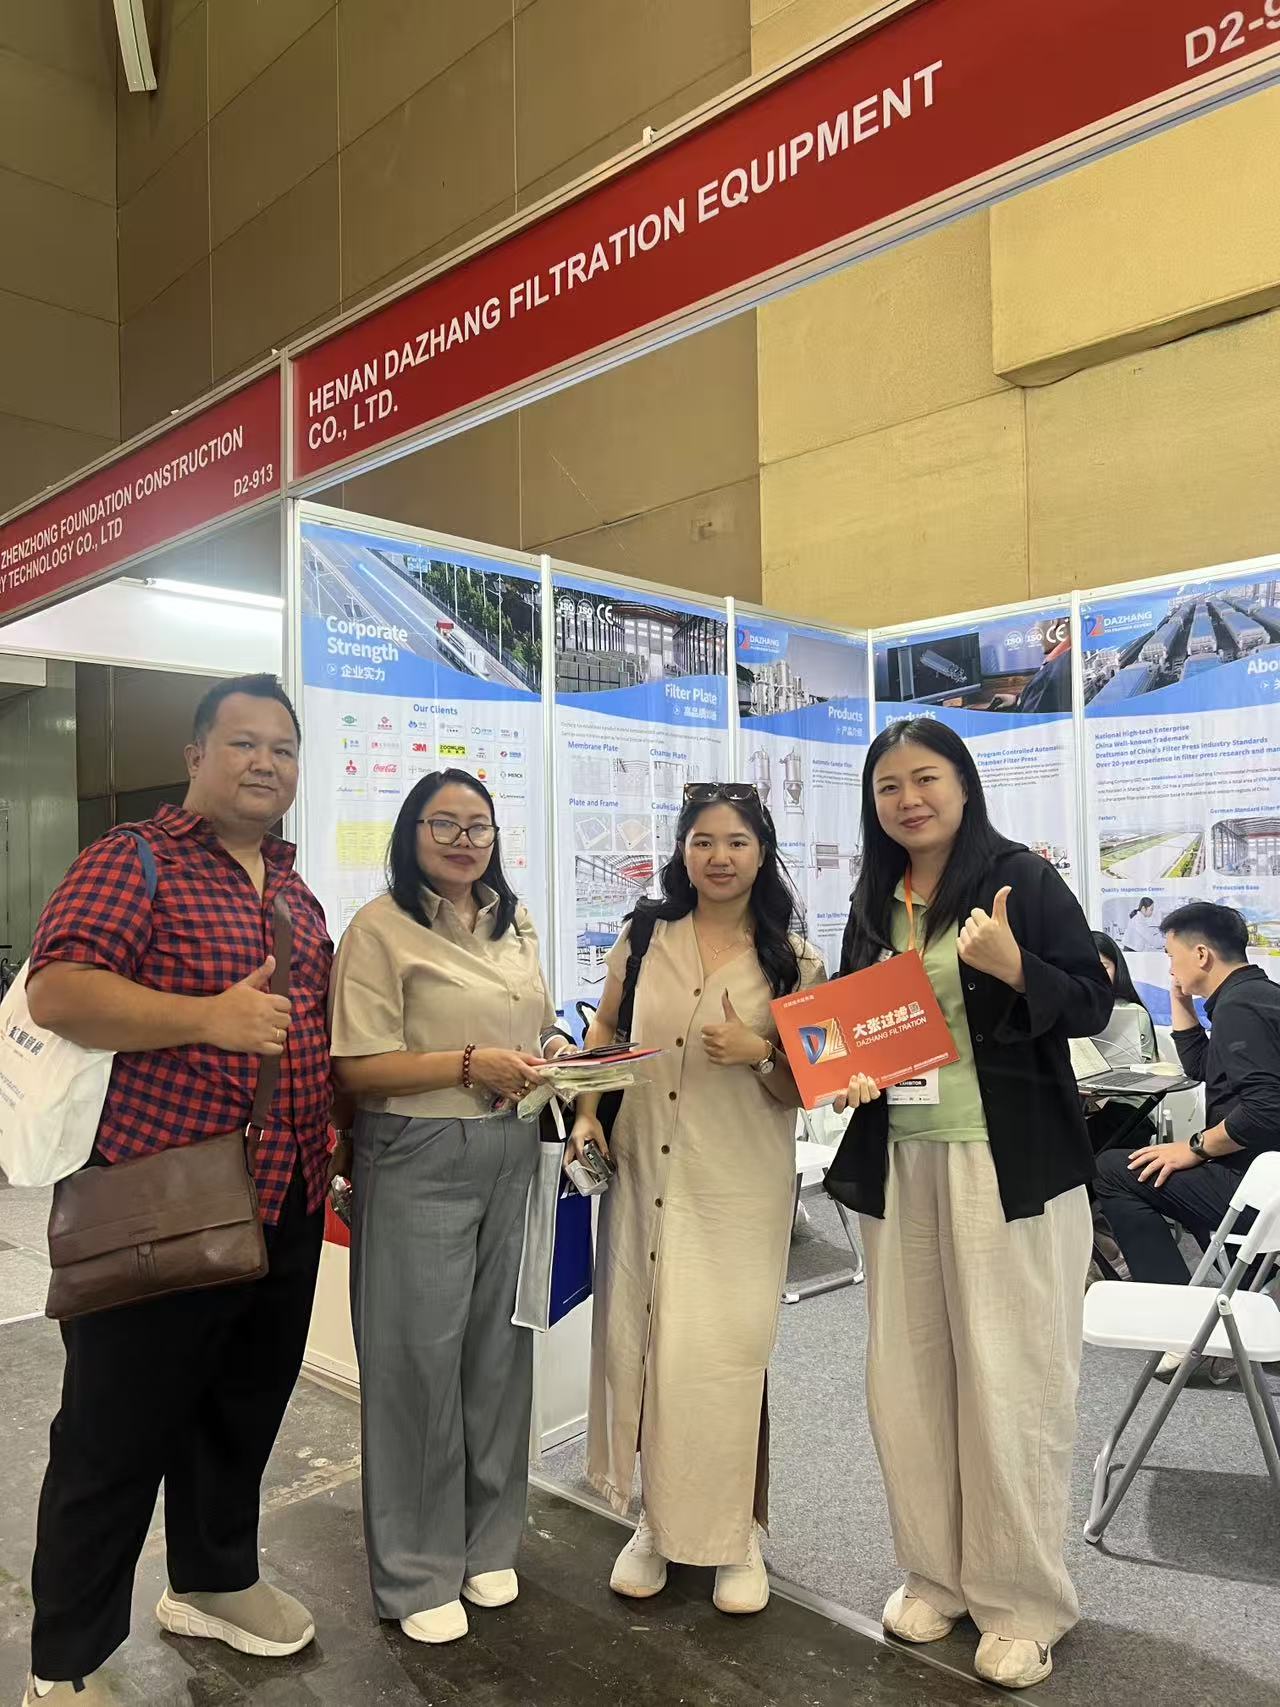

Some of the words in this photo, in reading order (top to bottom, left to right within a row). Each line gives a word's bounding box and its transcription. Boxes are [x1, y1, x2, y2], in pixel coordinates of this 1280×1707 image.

[308, 356, 378, 418] HENAN
[384, 297, 501, 379] DAZHANG
[509, 198, 685, 320] FILTRATION
[698, 60, 943, 223] EQUIPMENT
[308, 415, 347, 450] CO.,
[353, 389, 398, 429] LTD.
[234, 463, 273, 498] D2-913
[1, 524, 58, 569] ZHENZHONG
[60, 483, 132, 539] FOUNDATION
[135, 425, 243, 500] CONSTRUCTION
[8, 540, 74, 589] TECHNOLOGY
[76, 532, 98, 556] CO.,
[101, 517, 123, 545] LTD
[596, 603, 614, 625] CE
[1104, 611, 1152, 627] DAZHANG
[326, 615, 408, 642] Corporate
[1046, 623, 1066, 643] CE
[327, 636, 399, 664] Strength
[750, 634, 779, 647] DAZHANG
[341, 664, 386, 682] 企业实力
[665, 684, 691, 701] Filter
[693, 688, 718, 706] Plate
[413, 703, 429, 713] Our
[430, 706, 458, 715] Clients
[828, 706, 863, 722] Products
[1095, 731, 1121, 740] National
[1122, 728, 1153, 738] High-tech
[1154, 724, 1189, 734] Enterprise
[1114, 739, 1152, 748] Well-known
[1153, 734, 1189, 743] Trademark
[412, 743, 427, 752] 3M
[568, 741, 601, 751] Membrane
[603, 743, 619, 752] Plate
[977, 751, 1001, 759] Program
[1002, 747, 1034, 755] Controlled
[1137, 746, 1161, 755] China's
[1232, 736, 1268, 746] Standards
[1137, 756, 1172, 765] experience
[1199, 751, 1218, 759] press
[1219, 748, 1250, 757] research
[569, 798, 585, 806] Plate
[587, 799, 598, 807] and
[852, 1005, 909, 1039] 大张过滤
[856, 1031, 888, 1048] DAZHANG
[889, 1016, 927, 1036] FILTRATION
